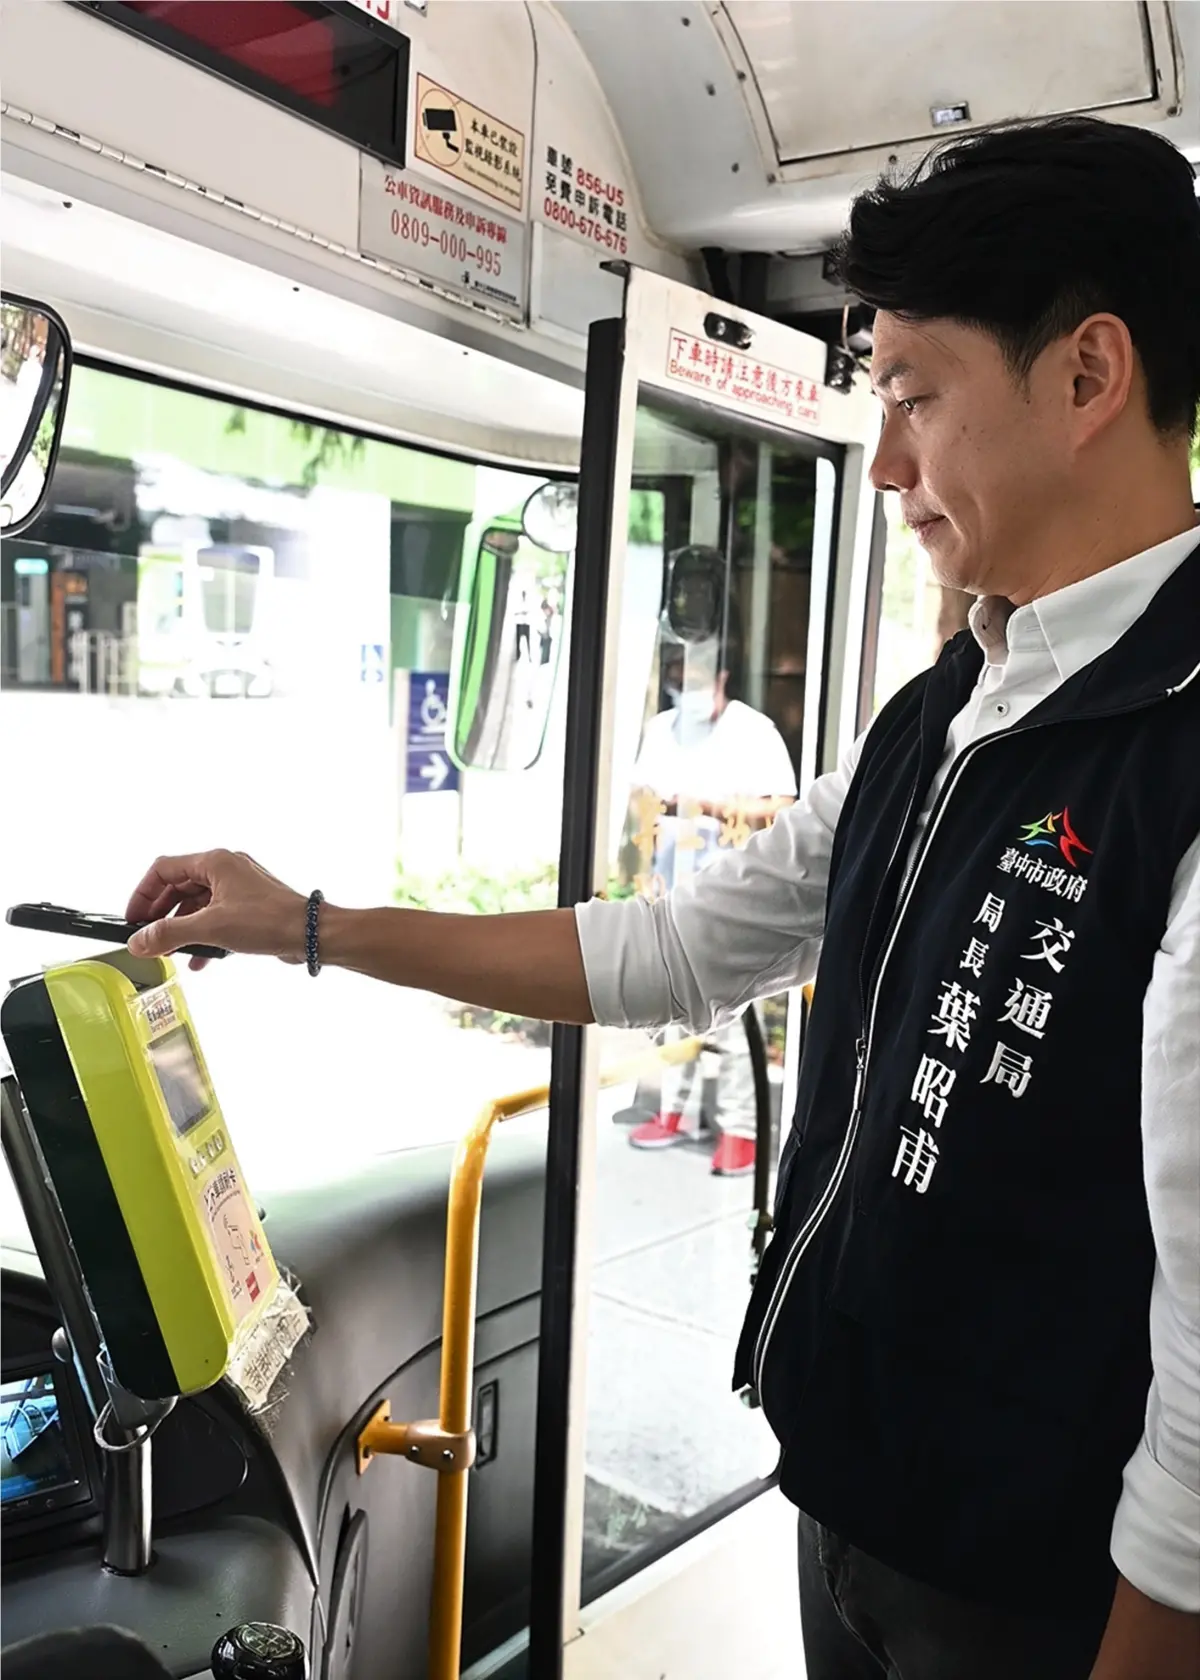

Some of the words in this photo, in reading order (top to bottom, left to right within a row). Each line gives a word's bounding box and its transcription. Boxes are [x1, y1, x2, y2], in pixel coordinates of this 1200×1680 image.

[465, 138, 522, 181] 監視錄影系統
[576, 167, 625, 207] 856-U5
[384, 174, 508, 244] 公車資訊服務及申訴專線
[543, 196, 628, 254] 0800-676-676
[545, 170, 627, 232] 免費申訴電話
[391, 208, 502, 276] 0809-000-995
[669, 359, 711, 386] Beware
[716, 376, 728, 391] of
[731, 383, 793, 417] approaching
[673, 336, 819, 405] 下車時請注意後方來車
[997, 847, 1088, 904] 臺中市政府
[979, 917, 1076, 1099] 交通局
